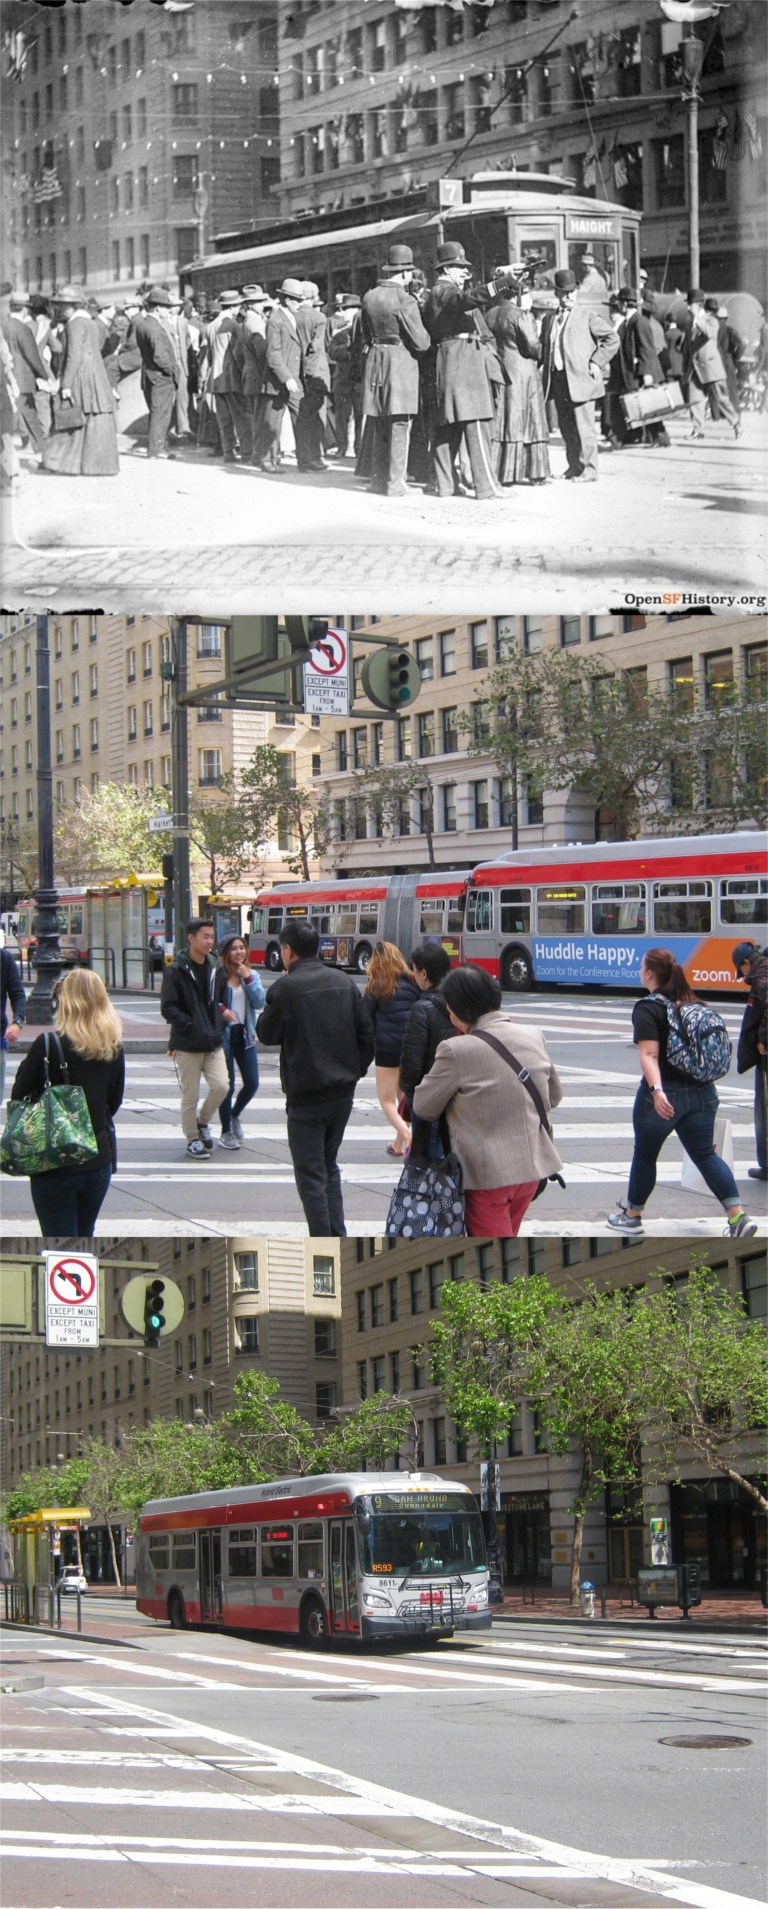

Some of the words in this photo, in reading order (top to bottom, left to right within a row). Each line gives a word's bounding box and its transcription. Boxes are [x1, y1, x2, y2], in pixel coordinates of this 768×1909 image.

[445, 184, 457, 201] 7
[570, 219, 613, 234] HAIGHT
[307, 677, 329, 686] EXCEPT
[331, 679, 346, 687] MUNI
[308, 688, 330, 697] EXCEPT
[332, 690, 346, 698] TAXI
[319, 697, 334, 705] FROM
[535, 943, 584, 960] Huddle
[587, 944, 639, 966] Happy.
[536, 966, 556, 976] Zoom
[557, 966, 566, 976] for
[567, 967, 579, 976] the
[580, 967, 620, 978] Conference
[49, 1307, 75, 1315] EXCEPT
[78, 1308, 95, 1316] MUNI
[50, 1319, 76, 1327] EXCEPT
[261, 1487, 276, 1497] Hybrid
[275, 1485, 292, 1495] Electric
[374, 1496, 382, 1509] 9
[394, 1495, 413, 1503] SAN
[417, 1495, 448, 1503] BRUNO
[372, 1564, 392, 1573] R593
